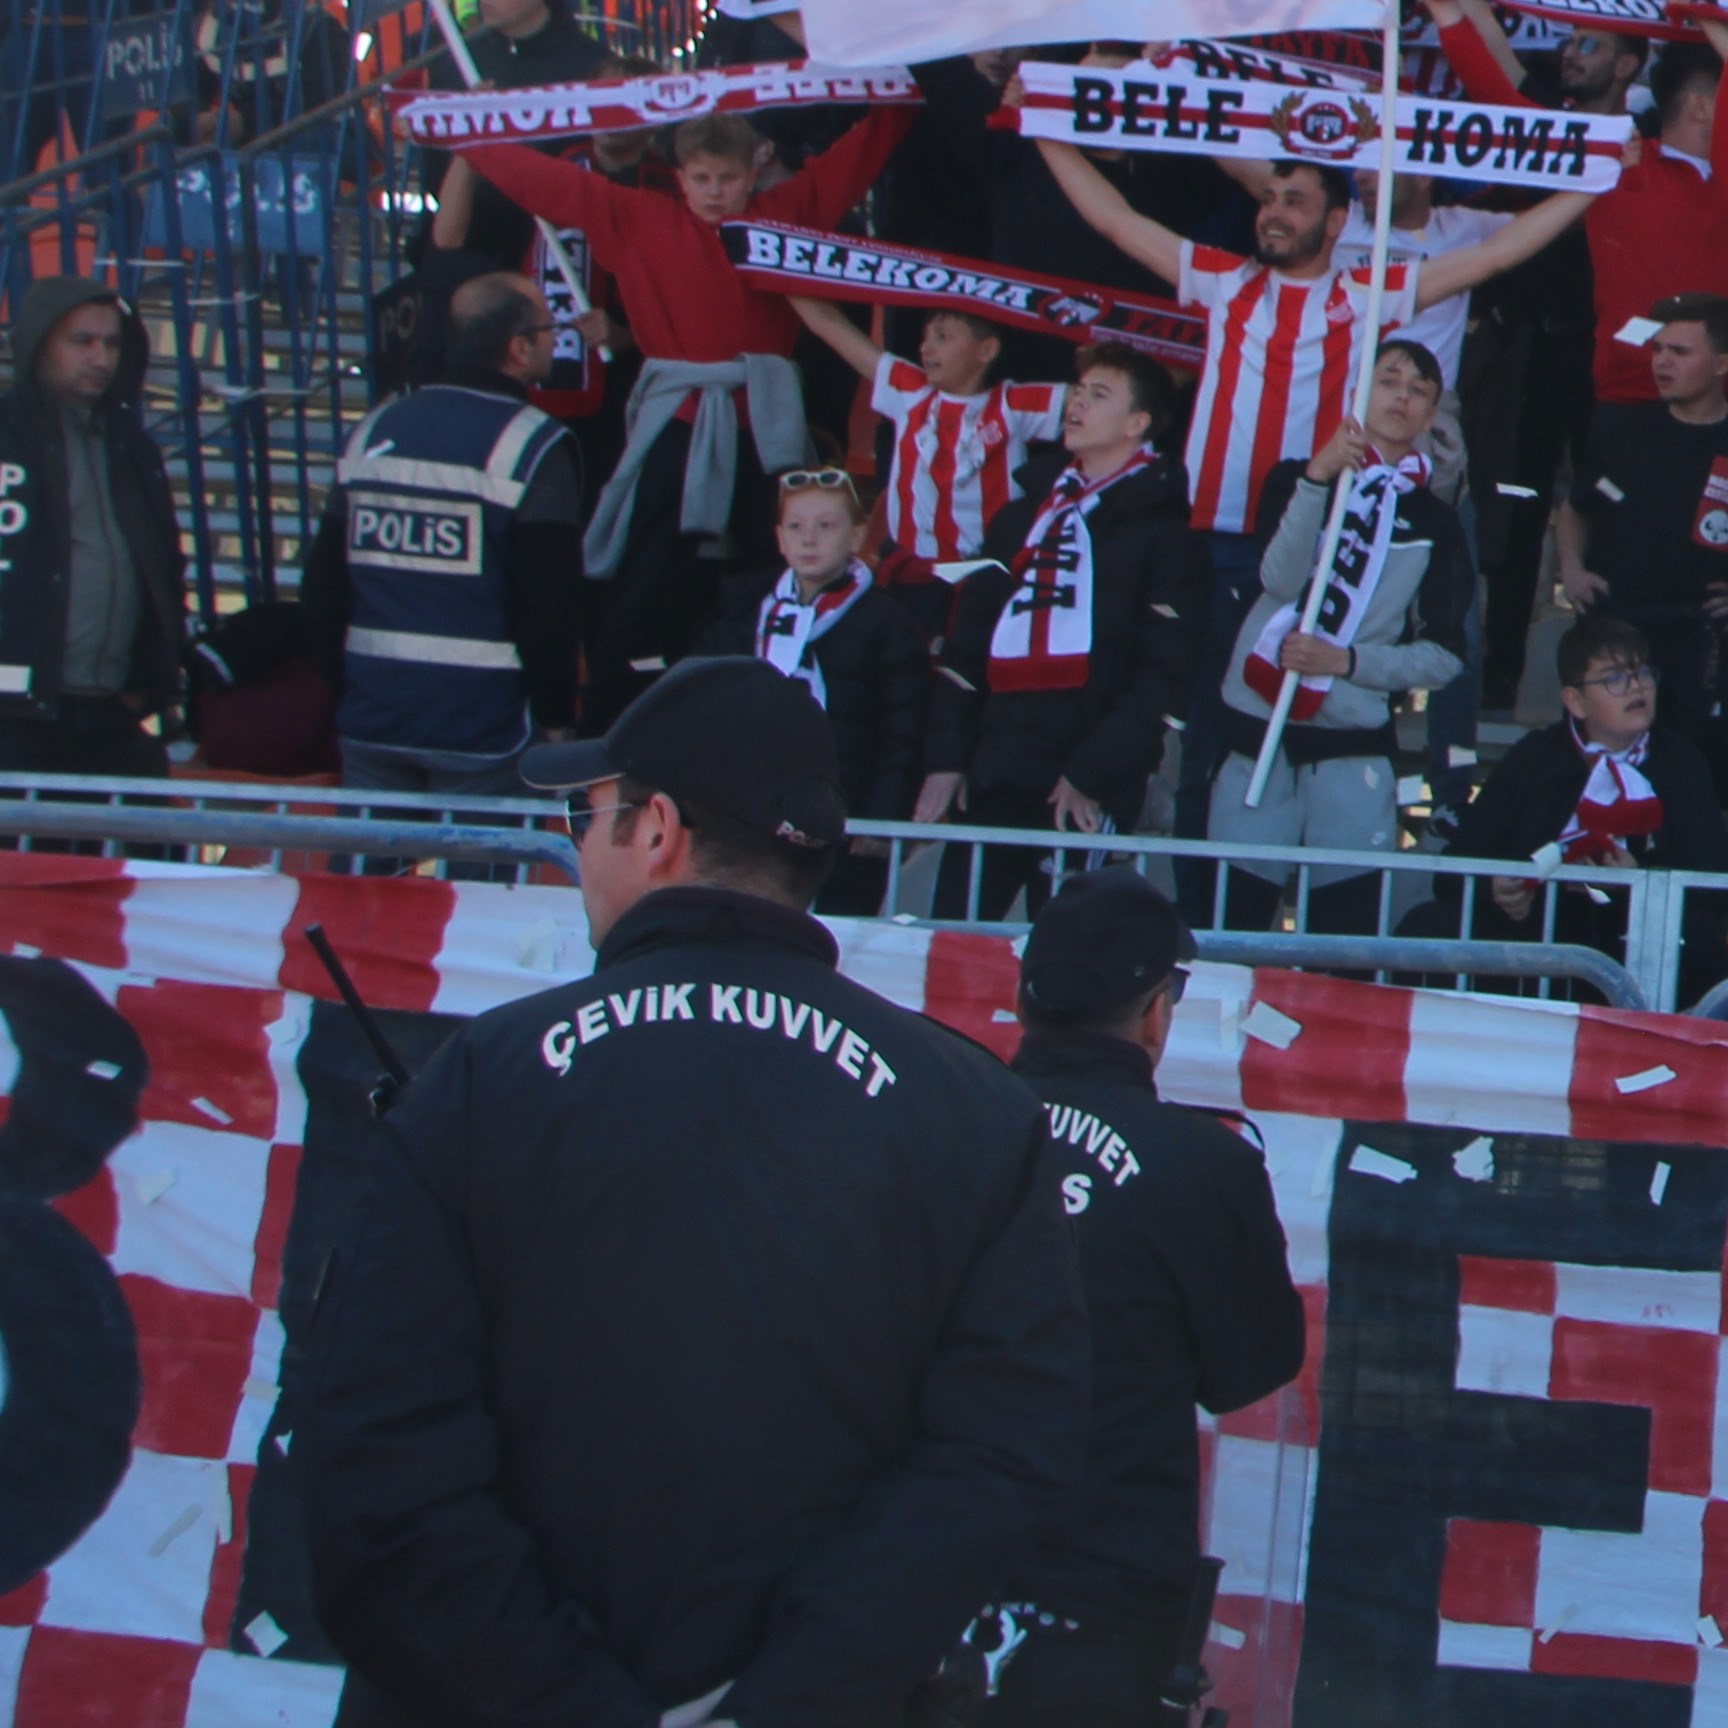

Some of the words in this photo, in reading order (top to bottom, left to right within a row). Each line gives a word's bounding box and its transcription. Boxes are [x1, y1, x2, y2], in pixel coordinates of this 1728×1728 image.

[1071, 76, 1244, 145] BELE
[1406, 108, 1590, 176] KOMA
[746, 228, 1034, 312] BELEKOMA
[353, 508, 464, 558] POLiS
[710, 982, 897, 1099] KUVVET
[1043, 1102, 1141, 1188] UVVET
